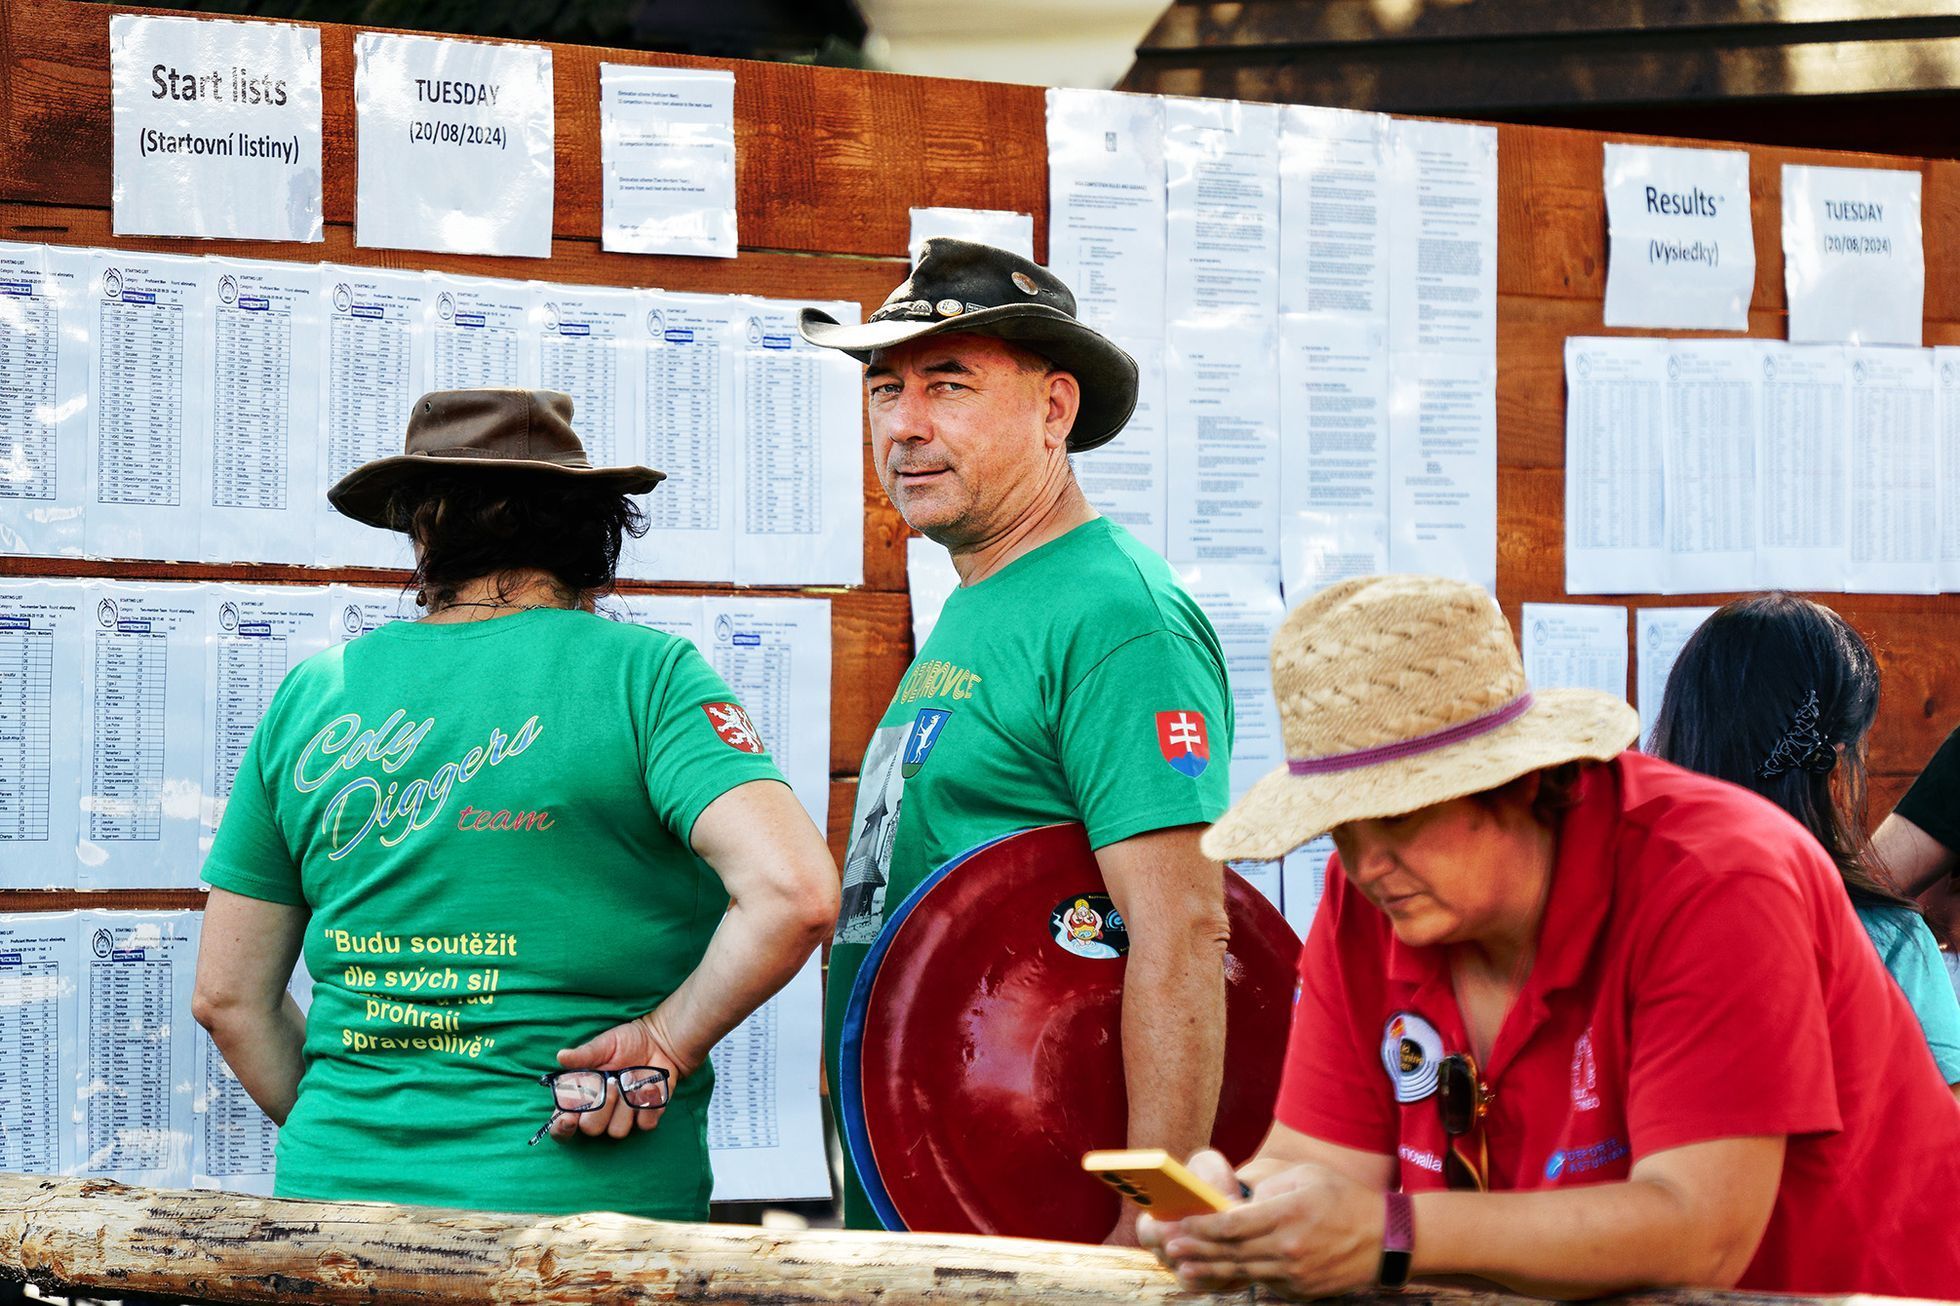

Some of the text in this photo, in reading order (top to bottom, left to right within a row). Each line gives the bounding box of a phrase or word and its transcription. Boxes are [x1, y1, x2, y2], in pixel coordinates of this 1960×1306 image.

[152, 64, 287, 106] Start lists
[415, 79, 500, 106] TUESDAY
[140, 127, 299, 164] (Startovní listiny)
[410, 120, 507, 150] (20/08/2024)
[1645, 186, 1718, 217] Results
[1825, 200, 1884, 222] TUESDAY
[1823, 235, 1893, 259] (20/08/2024)
[322, 715, 544, 861] Diggers
[458, 805, 556, 831] team
[325, 929, 518, 957] "Budu soutěžit
[345, 966, 500, 992] dle svých sil
[365, 999, 461, 1033] prohrají
